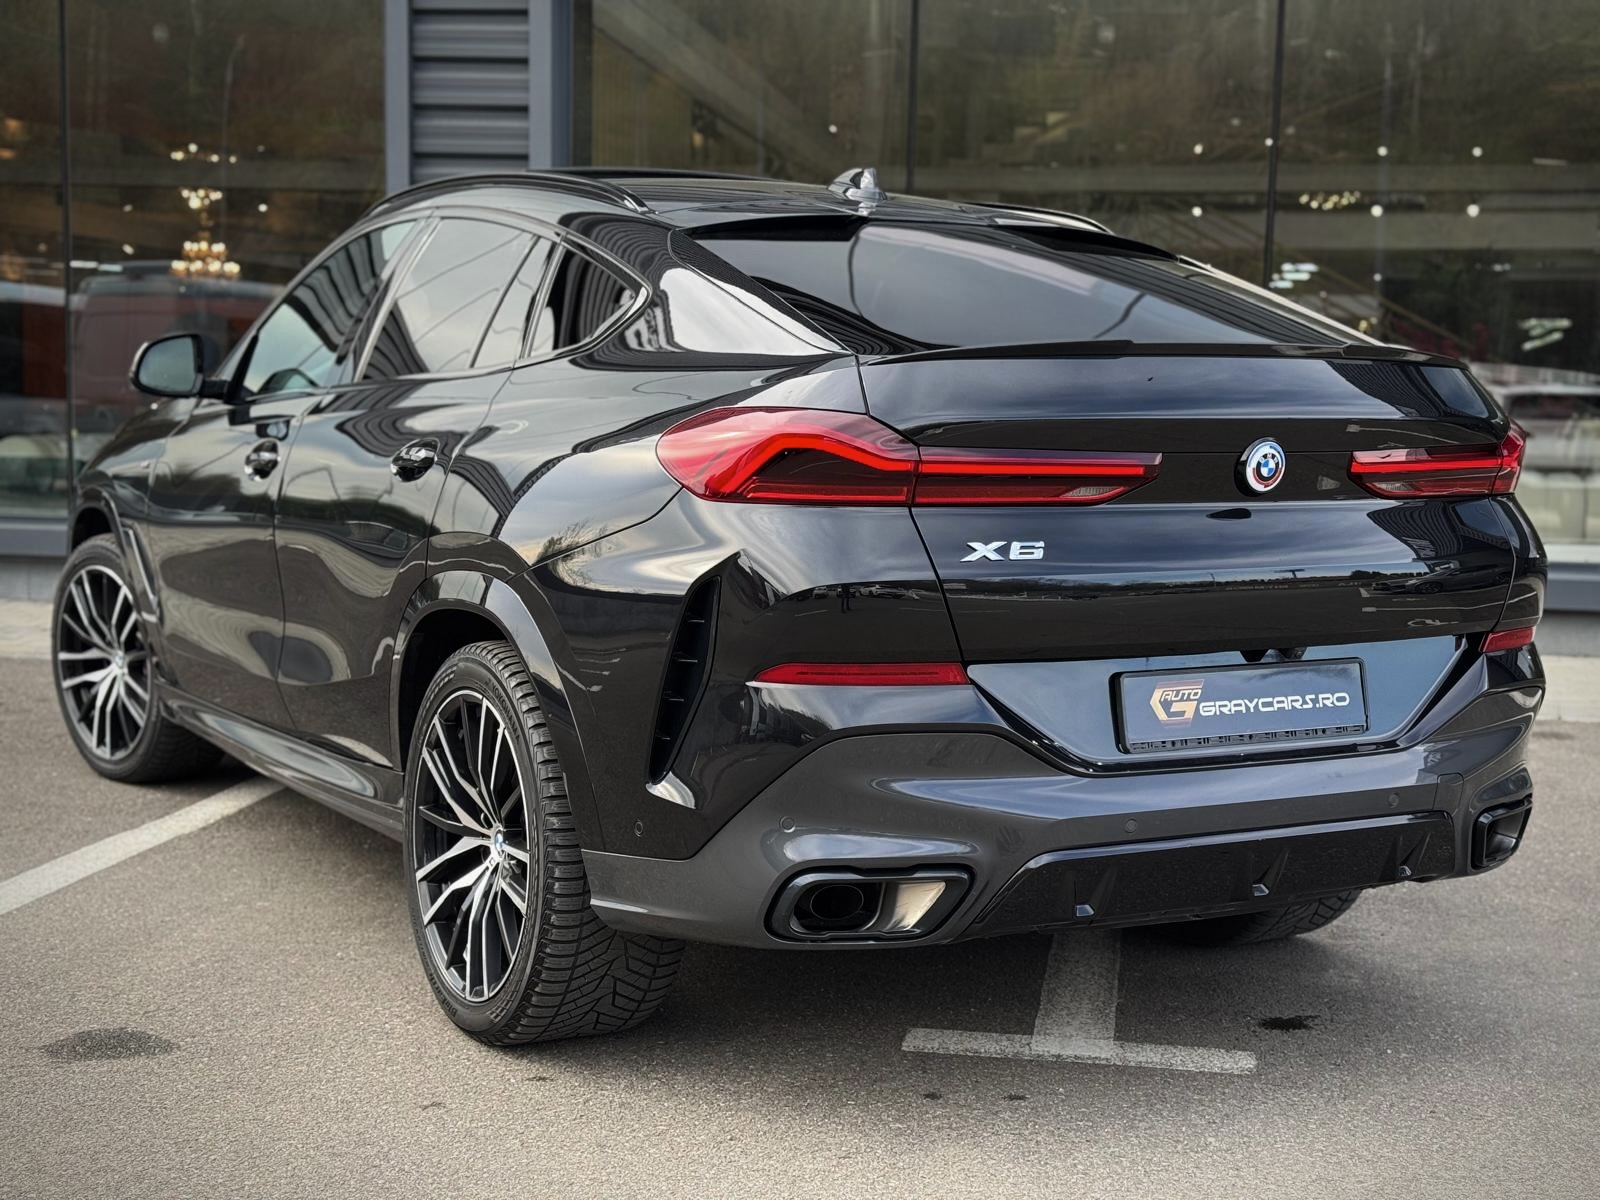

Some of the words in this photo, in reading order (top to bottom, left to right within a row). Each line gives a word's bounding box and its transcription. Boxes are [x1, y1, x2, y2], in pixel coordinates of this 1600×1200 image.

[960, 541, 1045, 561] X6
[1161, 689, 1202, 702] AUTO
[1199, 692, 1350, 716] GRAYCARS.RO
